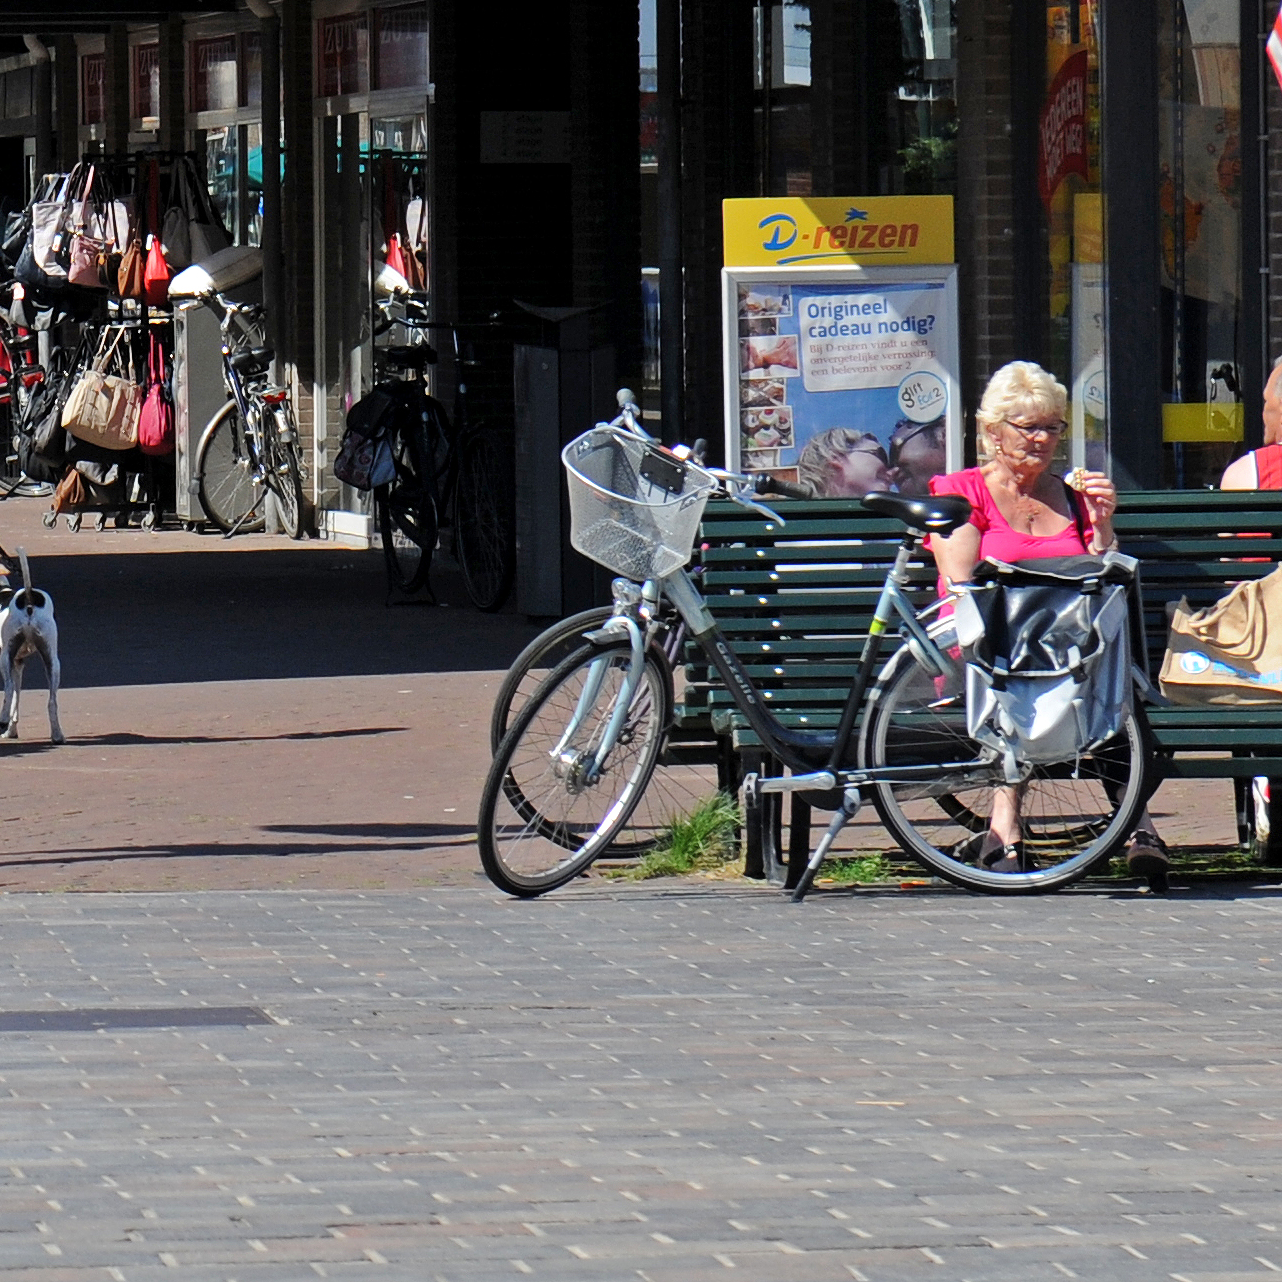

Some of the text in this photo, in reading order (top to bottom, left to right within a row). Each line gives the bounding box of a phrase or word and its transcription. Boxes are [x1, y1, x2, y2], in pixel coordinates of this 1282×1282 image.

[758, 212, 919, 251] D-reizen
[807, 298, 888, 321] Origineel
[809, 315, 936, 338] cadeau nodig?
[809, 345, 823, 355] Bij
[826, 343, 868, 352] D-reizen
[870, 340, 897, 349] vindt
[810, 353, 880, 365] onvergetelijke
[810, 368, 828, 377] een
[831, 364, 877, 375] belevenis
[905, 362, 912, 370] 2
[932, 387, 942, 398] 2
